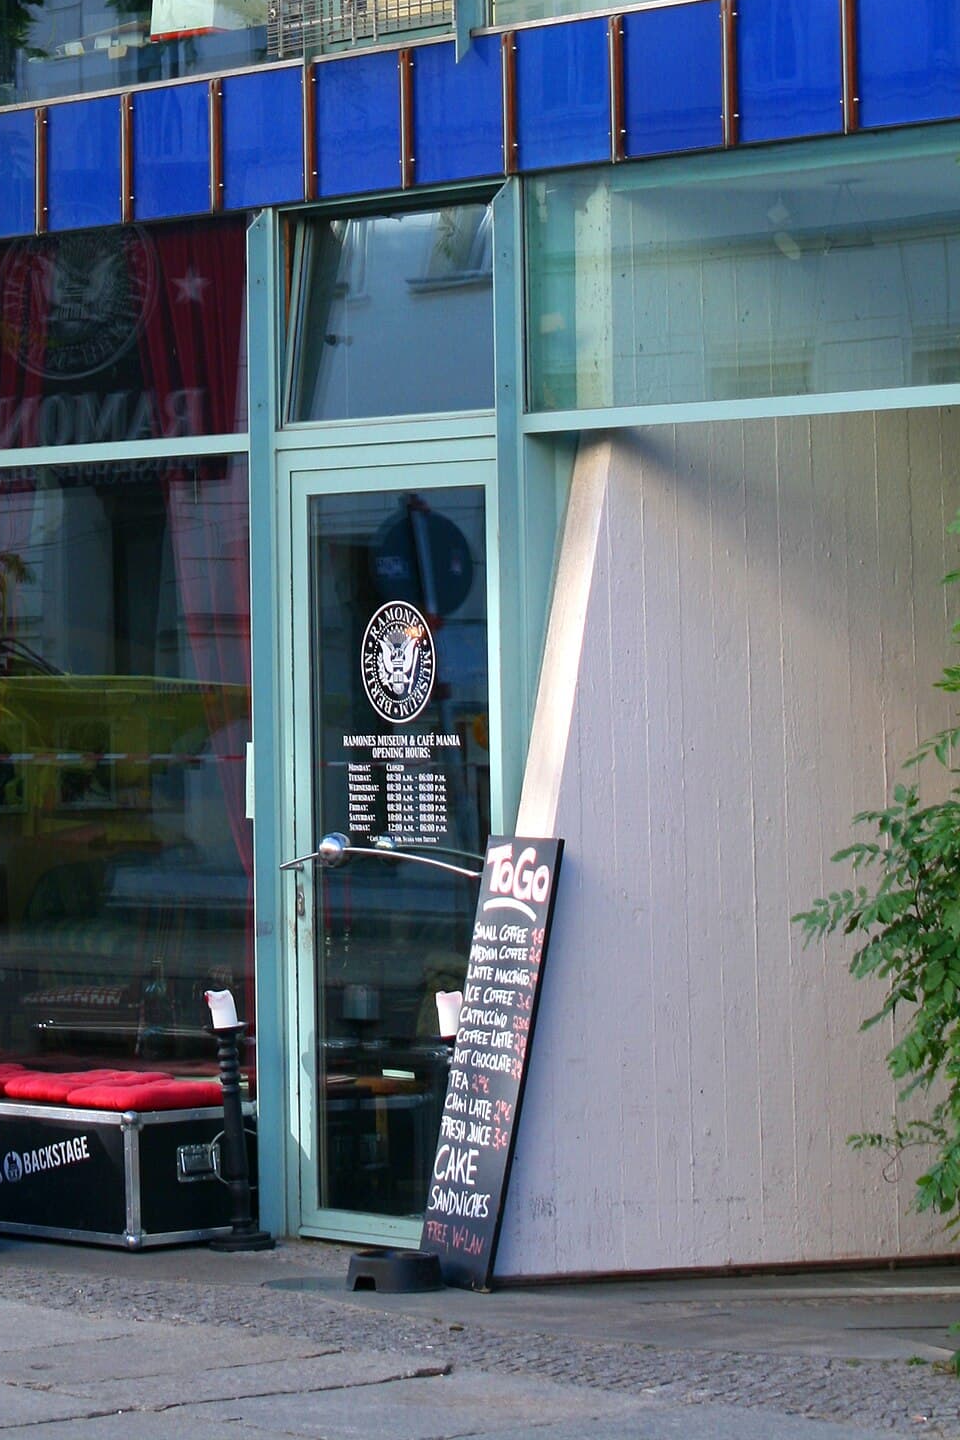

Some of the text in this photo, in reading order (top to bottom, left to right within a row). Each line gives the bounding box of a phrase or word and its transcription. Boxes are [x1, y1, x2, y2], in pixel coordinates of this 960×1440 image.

[370, 606, 425, 641] RAMONES
[365, 653, 393, 715] BERLIN
[400, 650, 432, 717] MUSEUM
[343, 732, 461, 746] RAMONES MUSEUM & CAFÉ MANIA
[372, 747, 431, 758] OPENING HOURS:
[499, 924, 528, 944] COFFEE
[499, 946, 528, 961] COFFEE
[467, 964, 494, 980] LATTE
[465, 983, 481, 1003] ICE
[483, 987, 515, 1006] COFFEE
[456, 1027, 491, 1045] COFFEE
[491, 1030, 514, 1049] LATTE
[454, 1047, 471, 1064] HOT
[471, 1050, 511, 1073] CHOCOLATE
[450, 1070, 468, 1090] TEA
[469, 1099, 492, 1121] LATTE
[441, 1116, 466, 1143] FRESH
[23, 1136, 90, 1175] BACKSTAGE
[433, 1144, 479, 1185] CAKE
